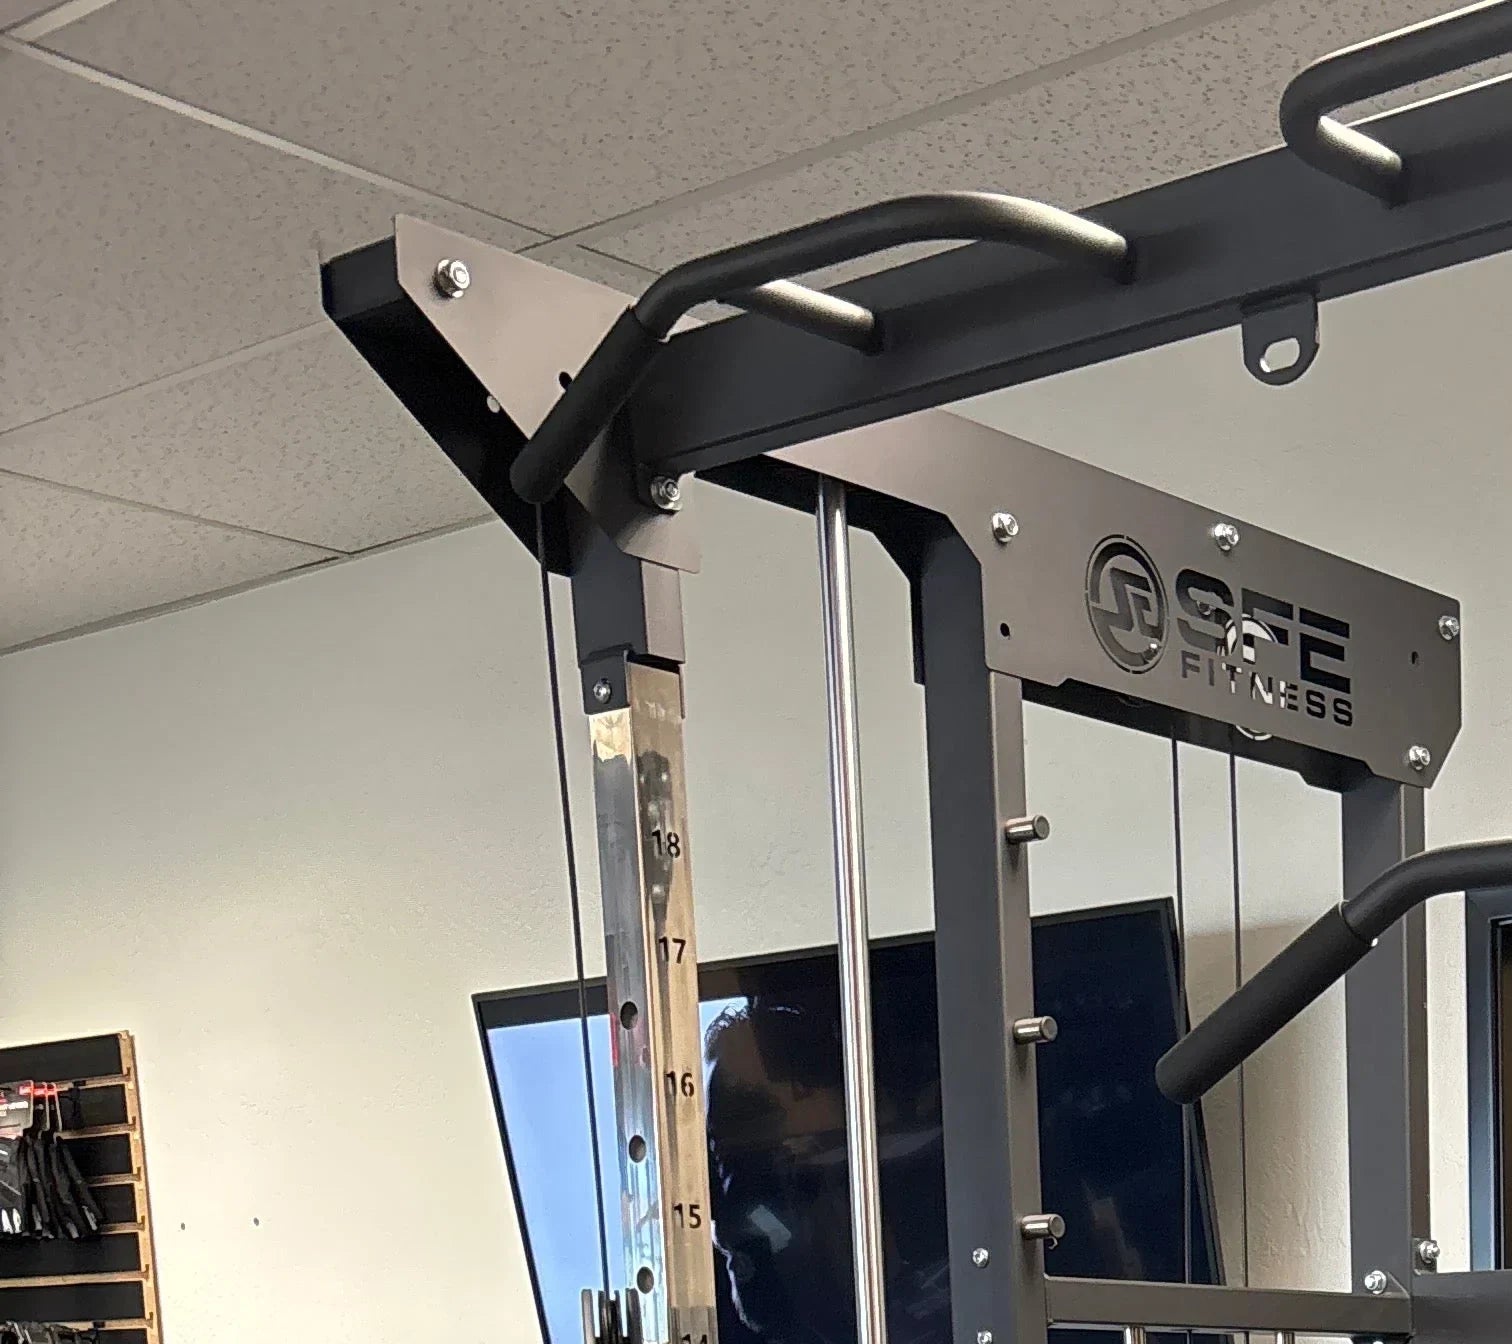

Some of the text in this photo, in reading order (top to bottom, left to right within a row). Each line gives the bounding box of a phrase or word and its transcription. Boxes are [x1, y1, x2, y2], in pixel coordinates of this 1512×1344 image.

[1175, 567, 1351, 695] SFE
[1180, 649, 1354, 728] FITNESS
[652, 829, 681, 859] 18
[659, 936, 687, 964] 17
[666, 1071, 695, 1098] 16
[674, 1203, 702, 1229] 15
